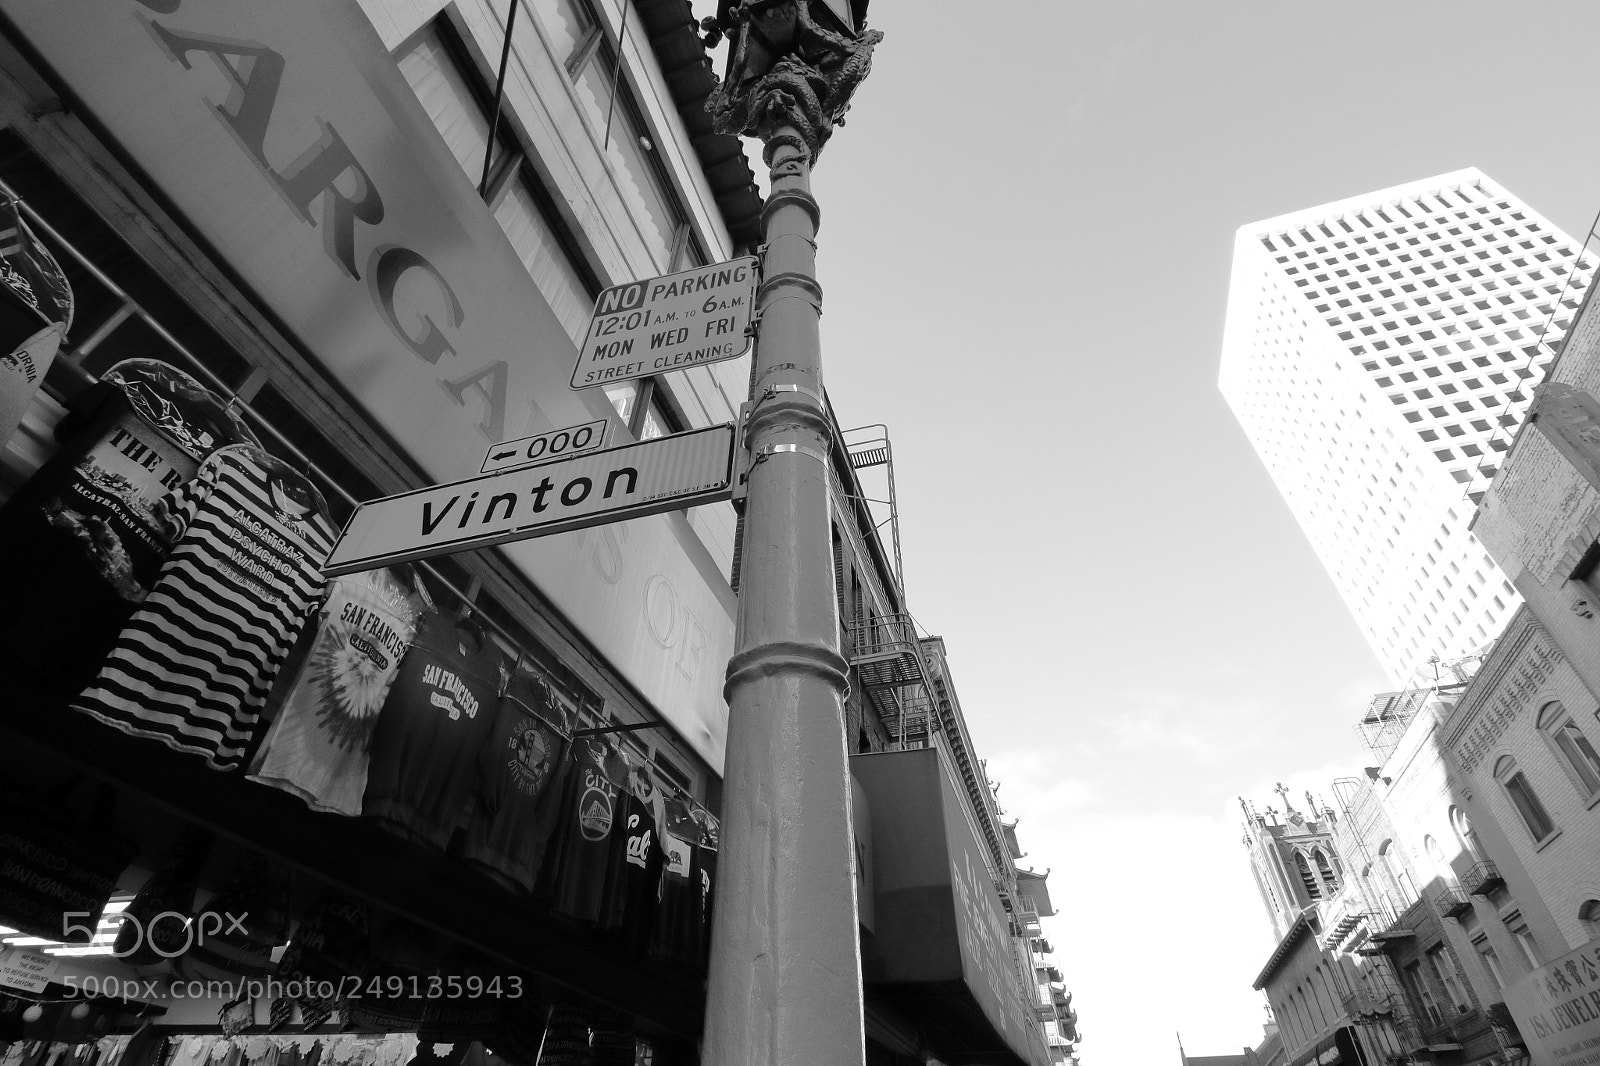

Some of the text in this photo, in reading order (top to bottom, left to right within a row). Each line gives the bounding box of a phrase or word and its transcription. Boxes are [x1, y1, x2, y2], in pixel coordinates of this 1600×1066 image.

[600, 266, 747, 313] NO PARKING
[592, 316, 736, 361] MON WED FRI
[595, 309, 652, 337] 12:01
[702, 296, 717, 313] 6
[16, 350, 37, 384] ORNIA
[585, 361, 645, 382] STREET
[654, 343, 733, 369] CLEANING
[109, 429, 163, 473] THE
[72, 483, 121, 514] ALCATRAZ
[120, 513, 136, 529] SAN
[421, 467, 638, 536] Vinton
[229, 527, 292, 576] PSYCHO
[233, 509, 305, 564] ALCATRAZ
[231, 547, 275, 585] WARD
[340, 602, 367, 627] SAN
[422, 664, 479, 720] SAN FRANCISCO
[585, 774, 617, 798] CITY
[1550, 988, 1600, 1032] JEWELR
